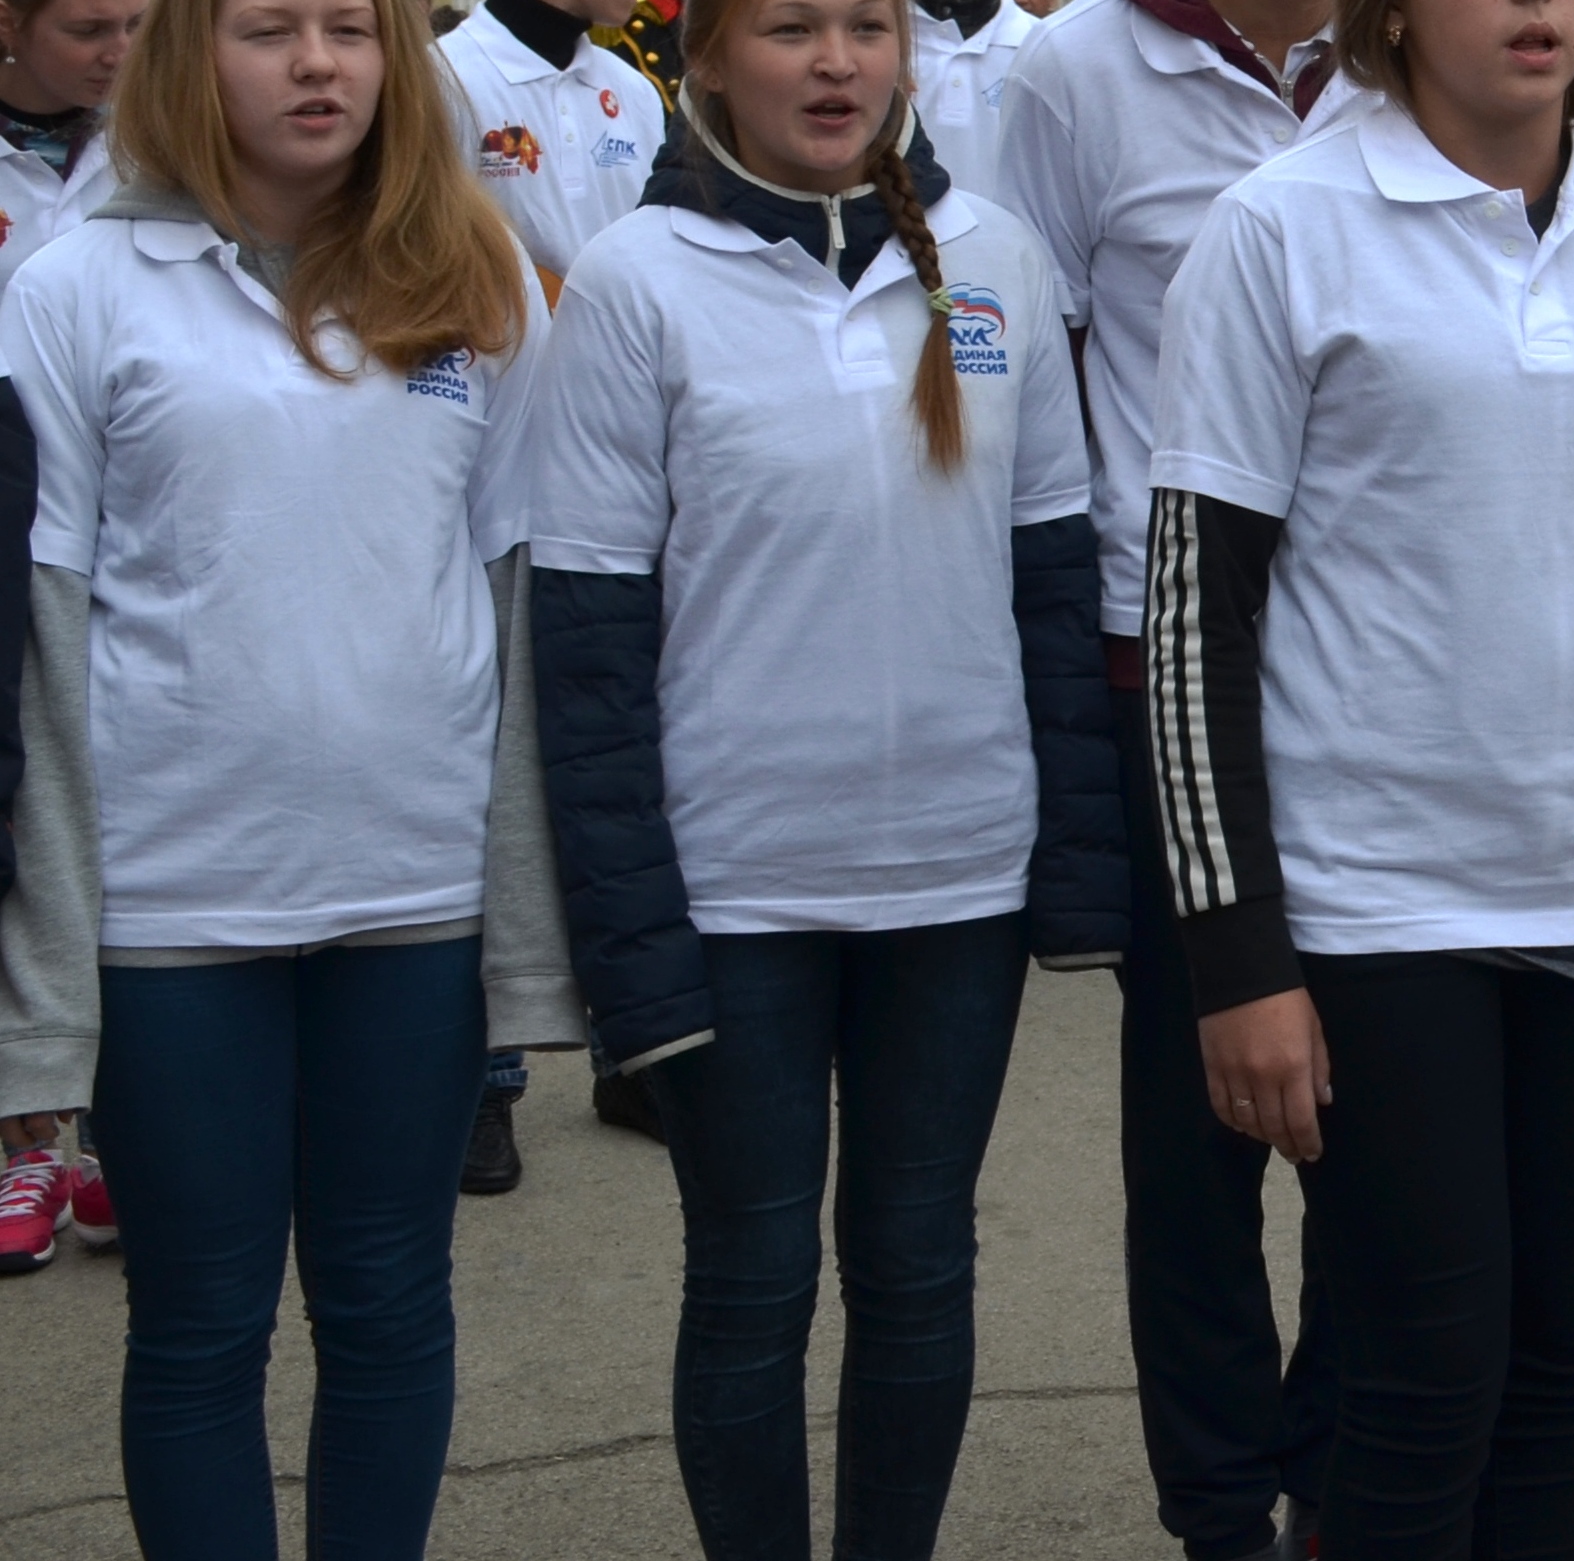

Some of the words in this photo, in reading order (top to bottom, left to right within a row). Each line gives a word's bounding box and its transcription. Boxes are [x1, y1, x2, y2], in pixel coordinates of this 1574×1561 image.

[953, 349, 1006, 361] ДИНАЯ
[952, 362, 1008, 375] ОССИЯ
[406, 370, 469, 392] ЕДИНАЯ
[406, 382, 469, 406] РОССИЯ
